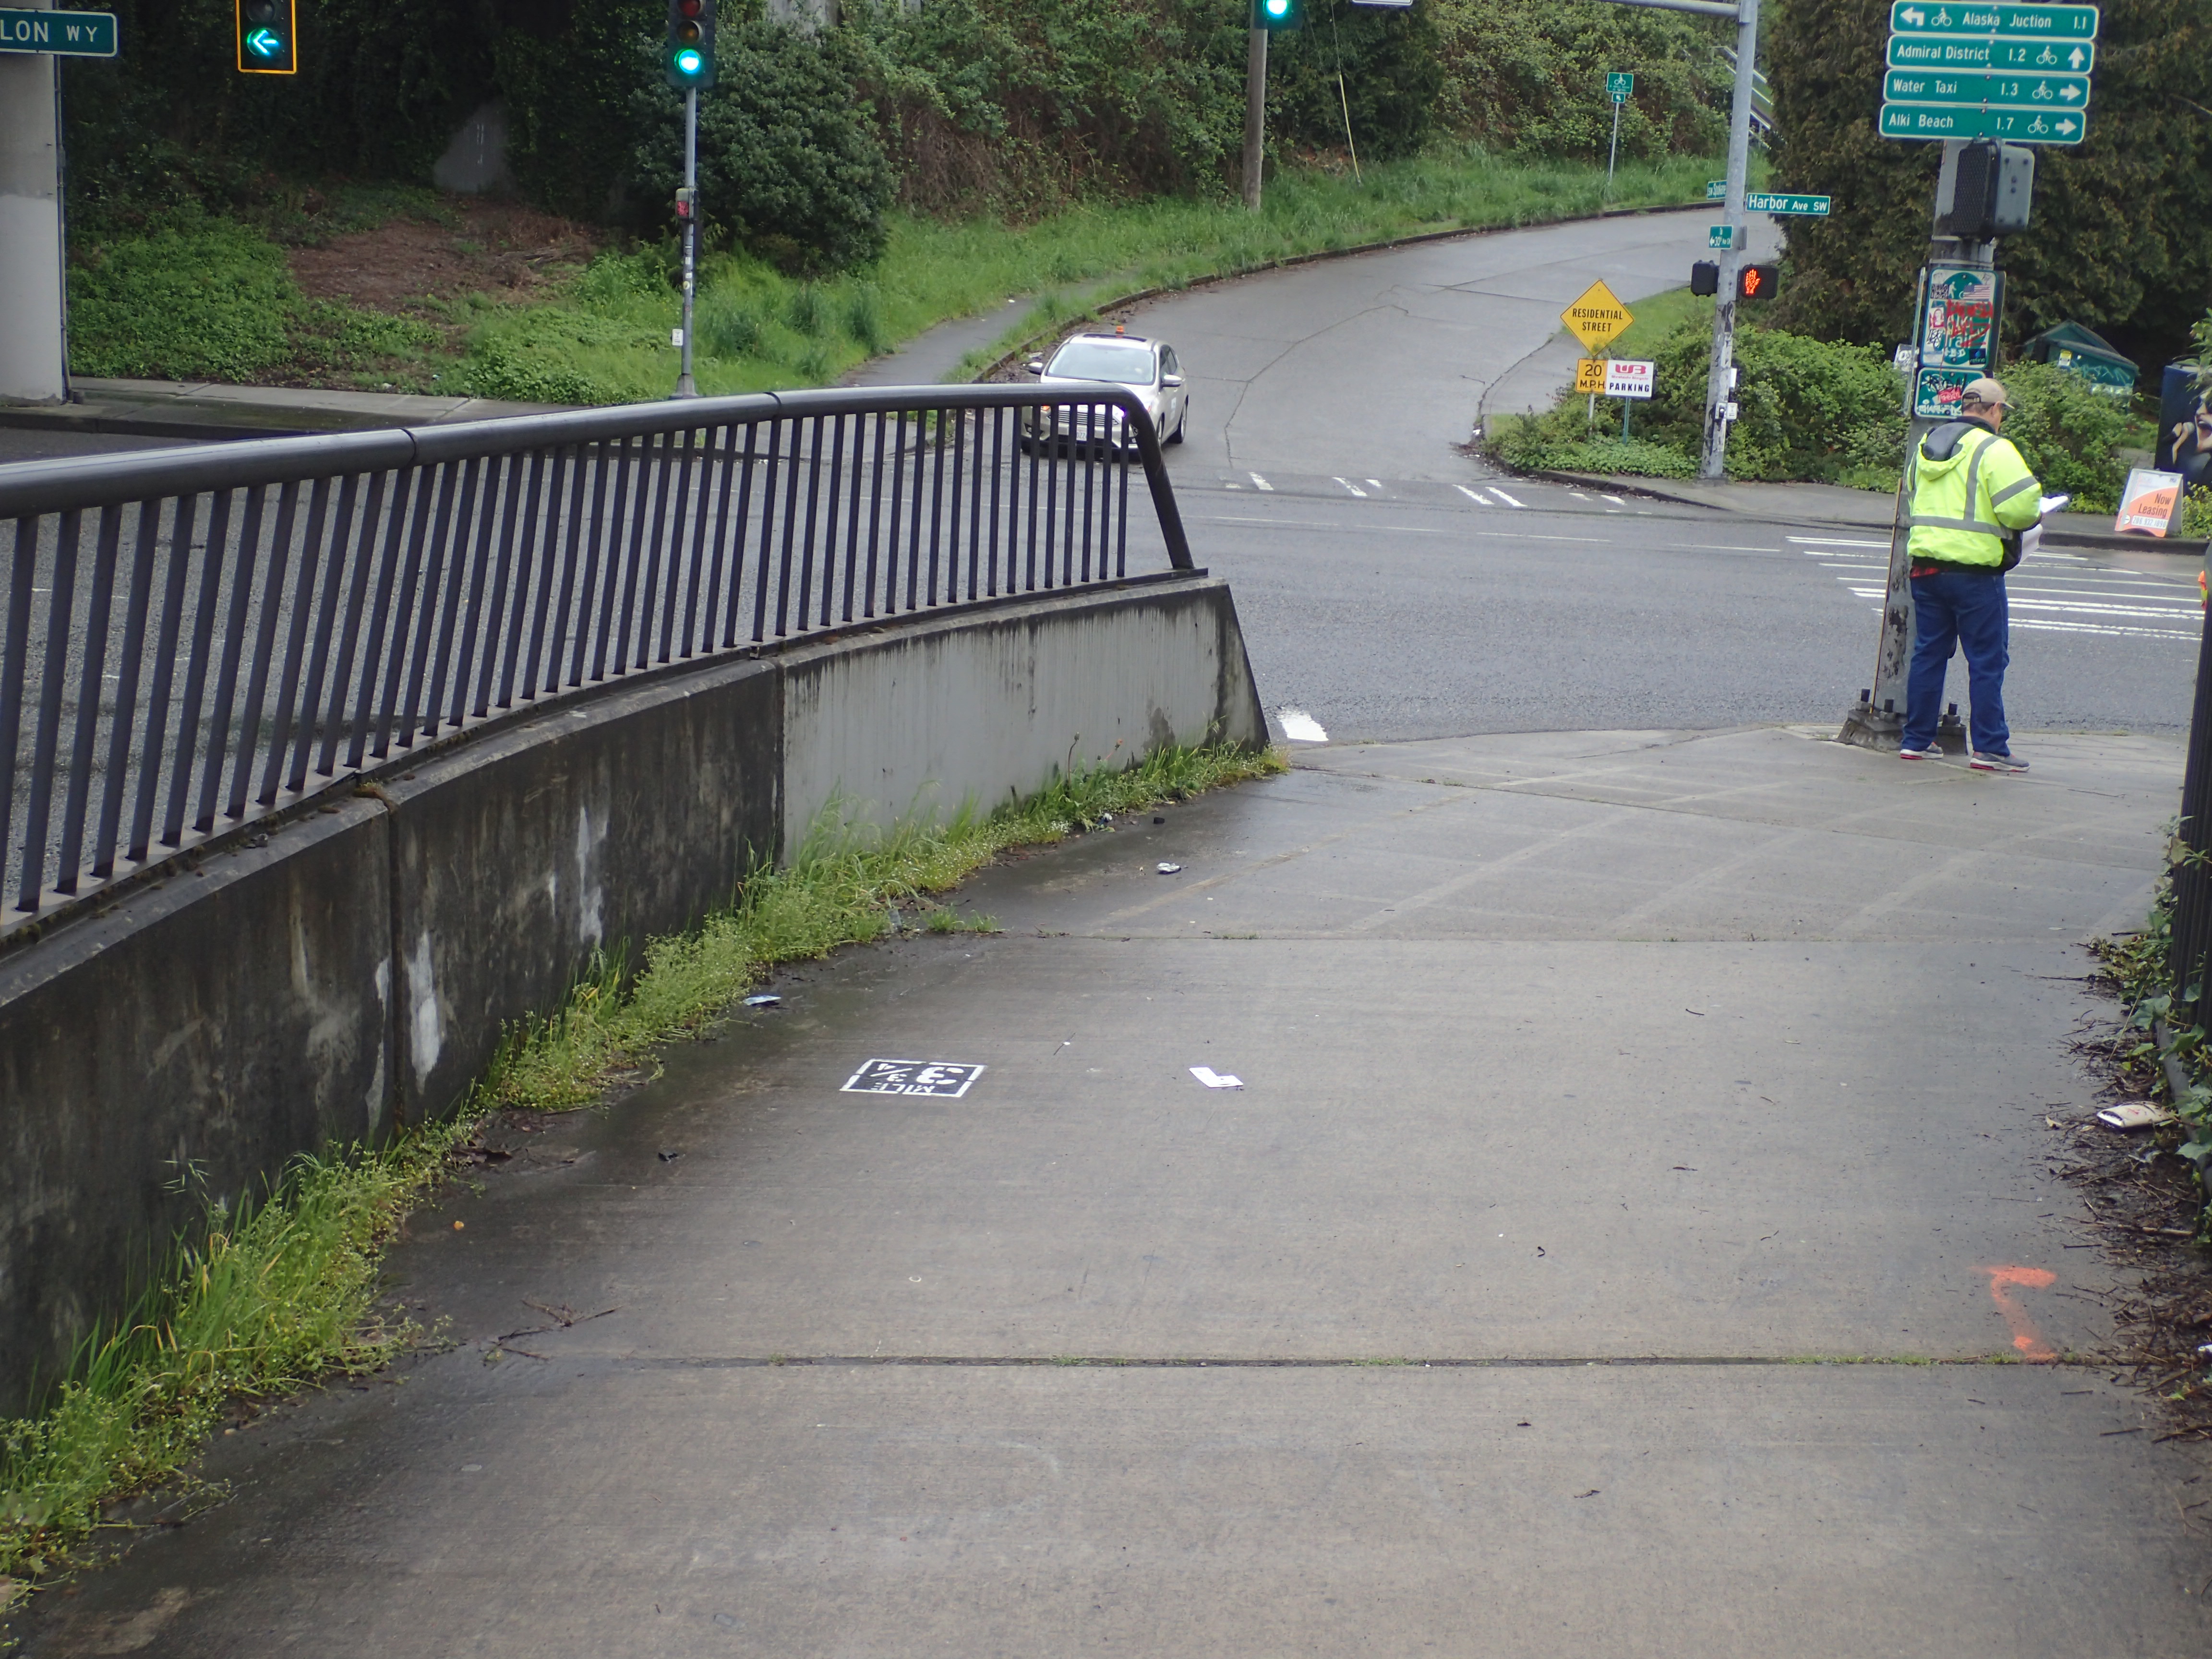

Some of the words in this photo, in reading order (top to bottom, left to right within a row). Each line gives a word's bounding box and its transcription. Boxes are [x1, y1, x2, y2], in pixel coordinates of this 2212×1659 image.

[1962, 12, 2000, 26] Alaska
[2009, 15, 2052, 28] Juction
[2074, 16, 2087, 30] 1.1
[0, 19, 48, 42] LON
[66, 25, 98, 42] WY
[1897, 45, 1941, 59] Admiral
[1946, 47, 1989, 60] District
[2008, 49, 2026, 62] 1.2
[1893, 78, 1925, 92] Water
[1935, 80, 1957, 94] Taxi
[2001, 83, 2018, 96] 1.3
[1889, 113, 1910, 126] Alki
[1919, 114, 1953, 128] Beach
[1996, 117, 2014, 130] 1.7
[1749, 195, 1788, 210] Harbor
[1792, 201, 1808, 210] Ave
[1813, 202, 1827, 211] SW
[1573, 308, 1623, 320] RESIDENTIAL
[1582, 322, 1612, 332] STREET
[1585, 364, 1602, 376] 20
[1610, 382, 1649, 392] PARKING
[2154, 493, 2172, 505] Now
[2138, 503, 2167, 518] Leasing
